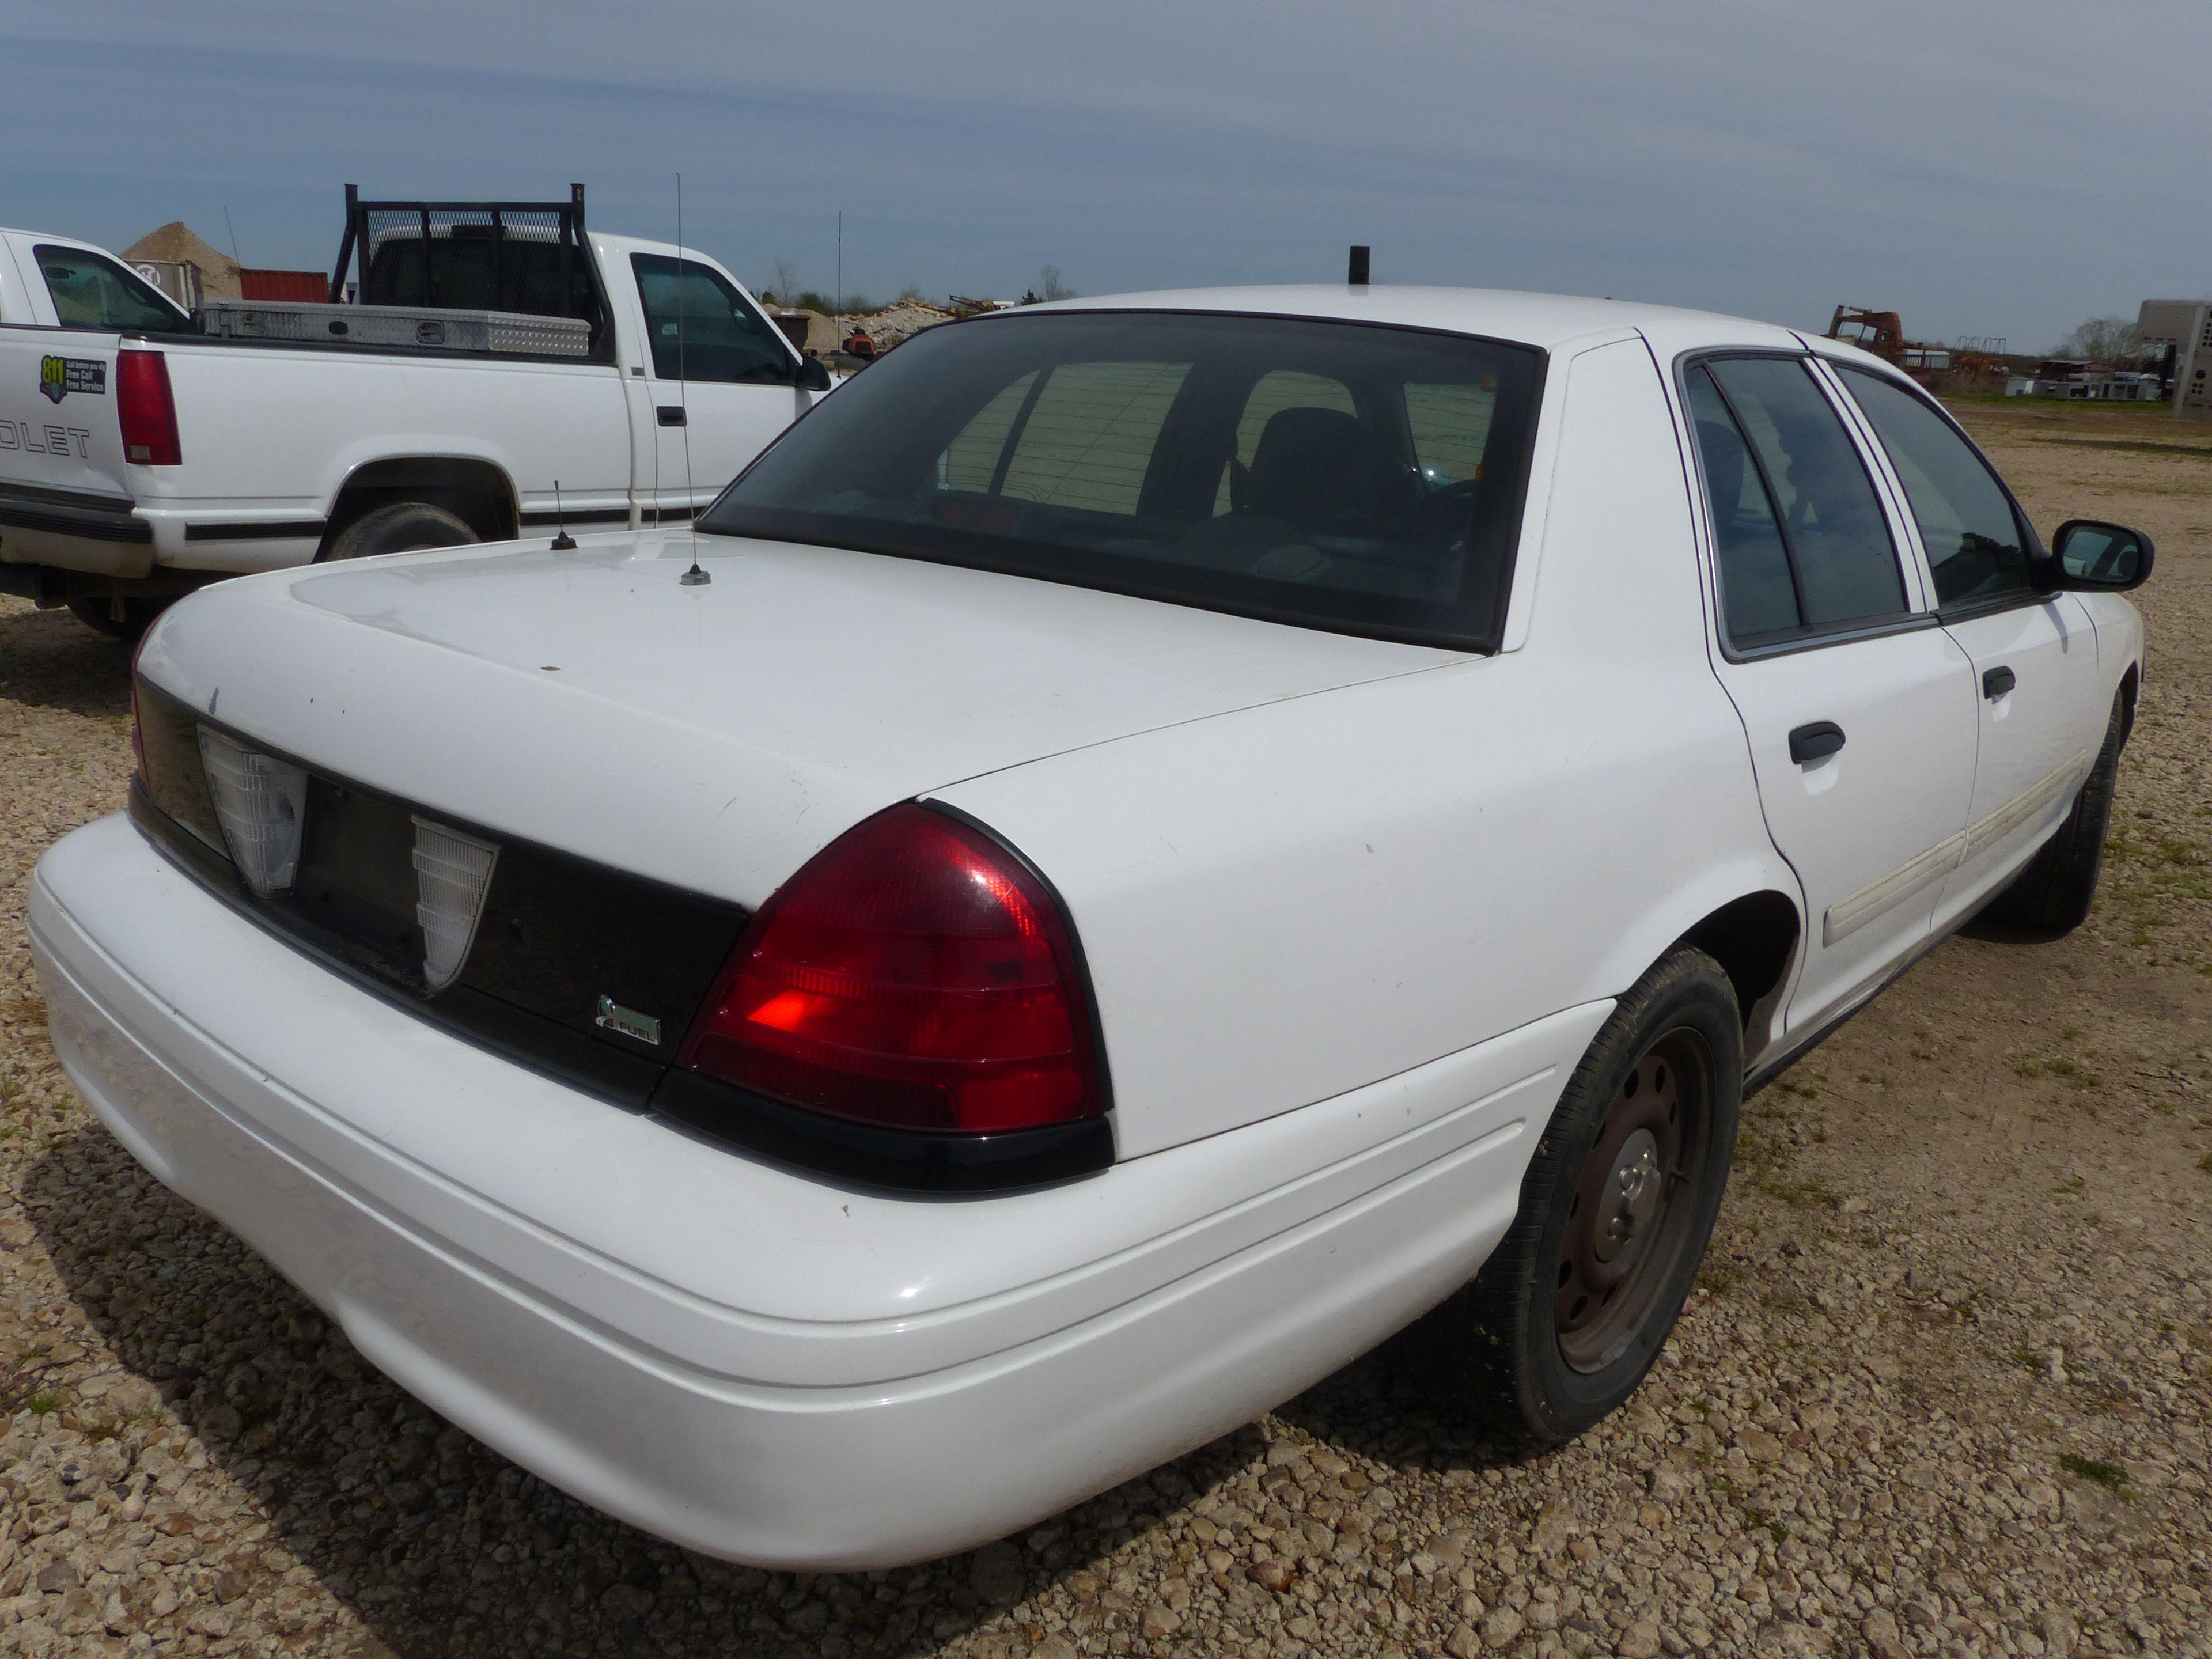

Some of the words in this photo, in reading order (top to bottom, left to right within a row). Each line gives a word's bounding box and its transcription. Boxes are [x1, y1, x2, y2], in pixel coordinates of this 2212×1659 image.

[43, 357, 63, 384] 811
[66, 369, 79, 379] Free
[81, 370, 93, 380] Call
[66, 380, 79, 389] Free
